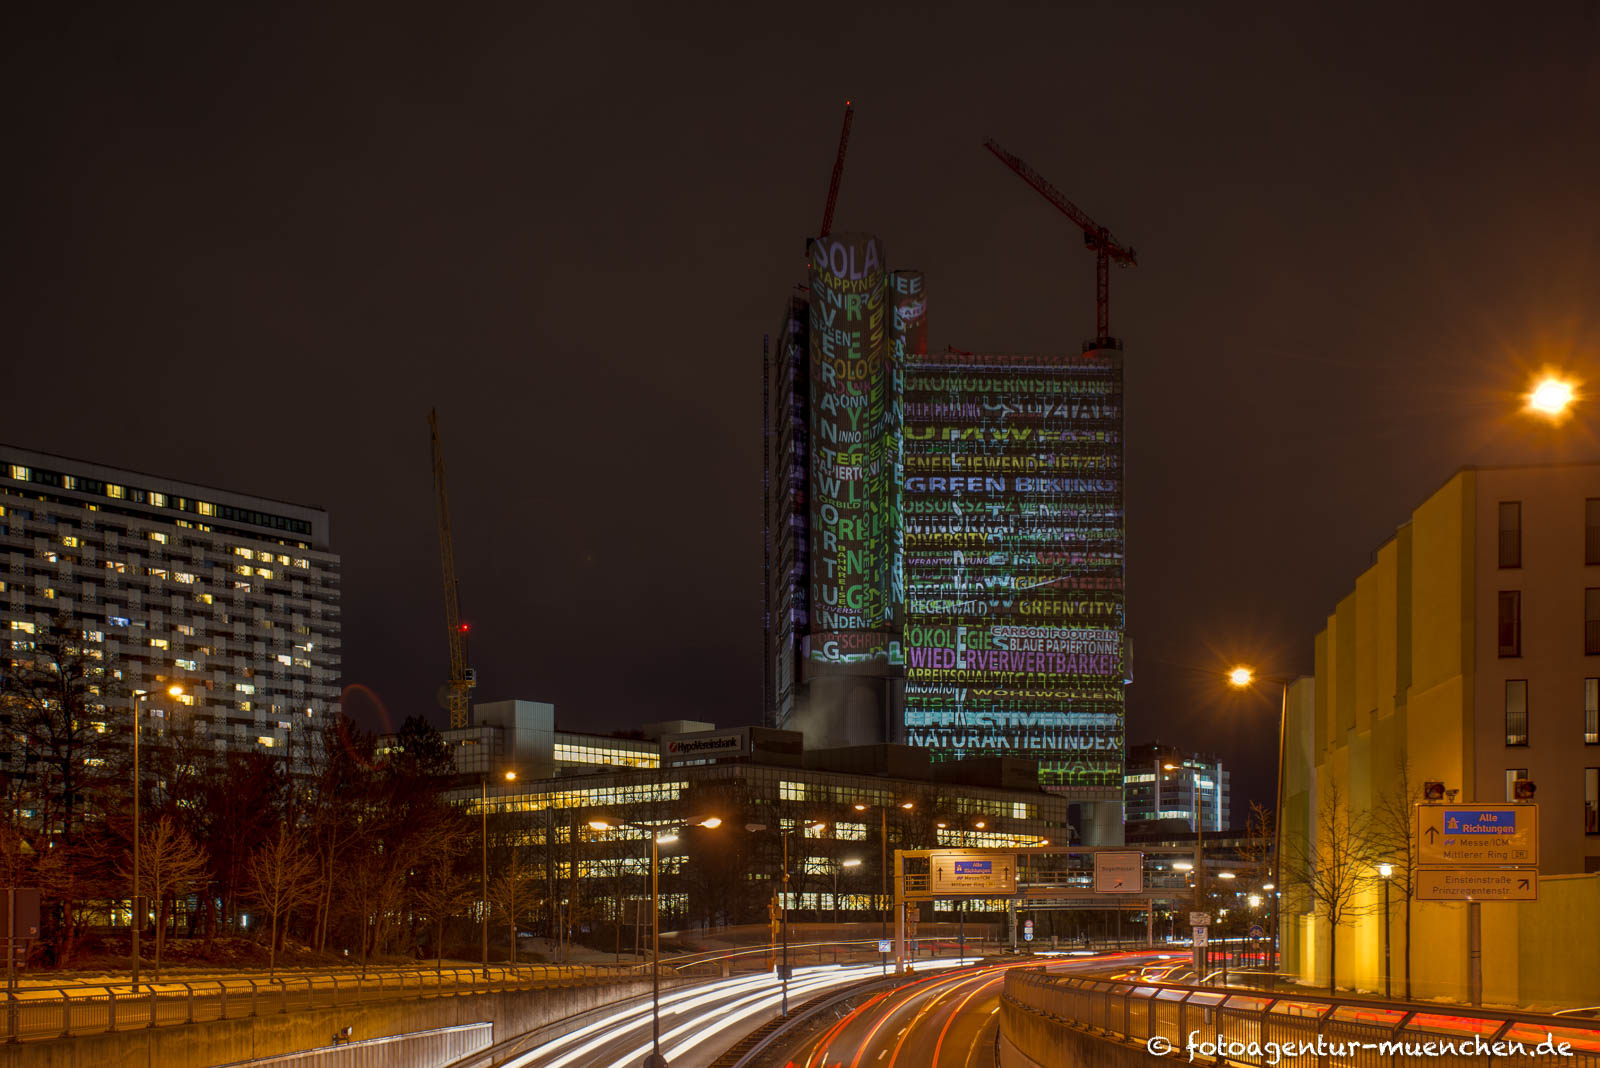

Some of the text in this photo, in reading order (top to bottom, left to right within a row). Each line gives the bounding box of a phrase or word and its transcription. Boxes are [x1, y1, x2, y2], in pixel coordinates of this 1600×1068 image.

[905, 477, 1006, 494] GREEN
[990, 627, 1050, 639] CARBON
[1009, 638, 1118, 655] BLAUE PAPIERTONNE
[973, 689, 1117, 699] WOHLWOLLEN
[678, 738, 737, 753] HypoVereinsbank
[1479, 813, 1498, 822] Alle
[1462, 824, 1514, 834] Richtungen
[1443, 851, 1483, 859] Mittlerer
[1487, 851, 1508, 860] Ring
[1445, 876, 1512, 885] Einsteinstraße
